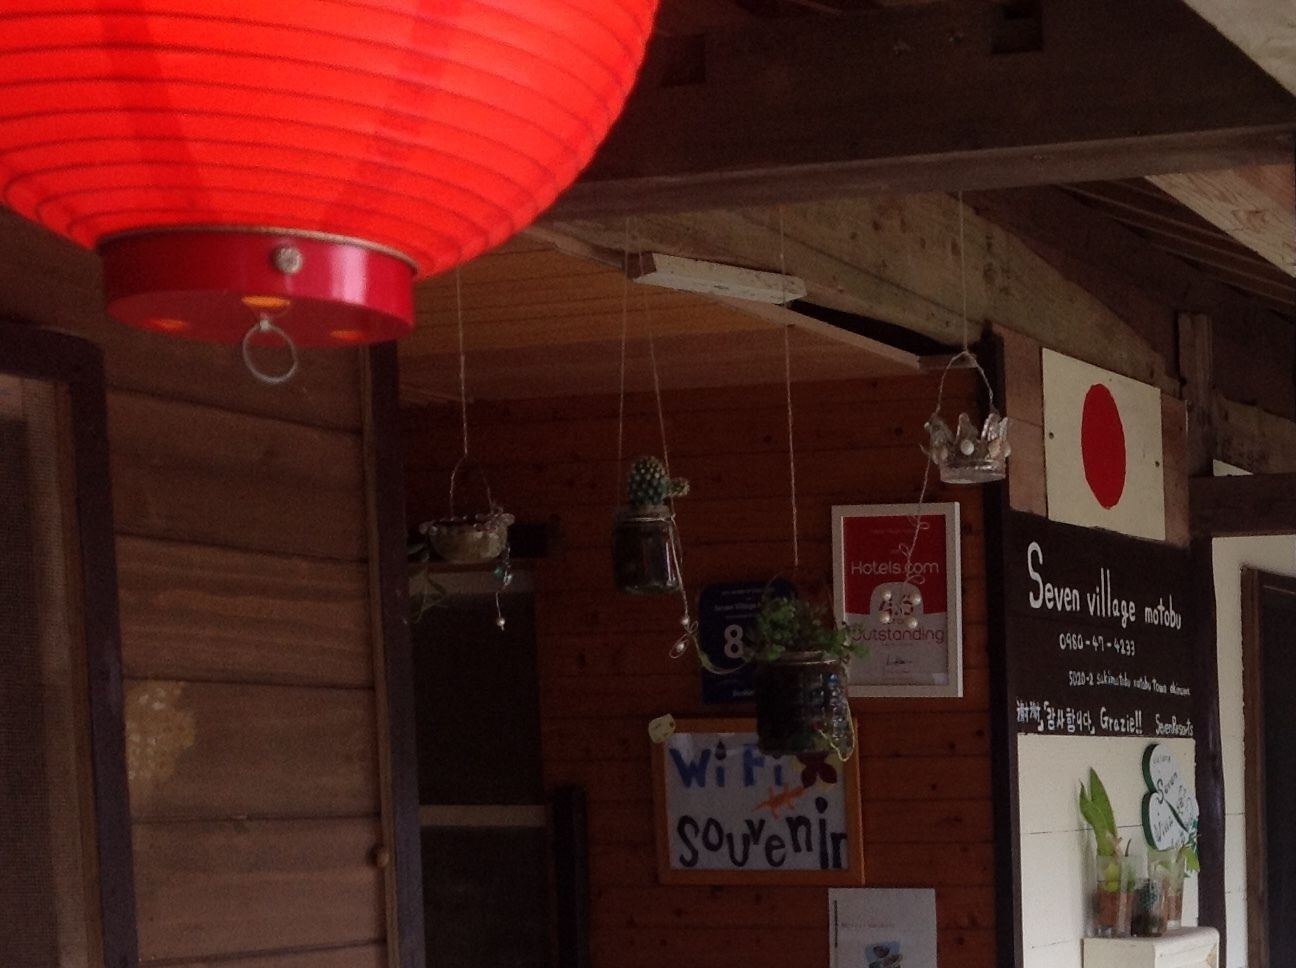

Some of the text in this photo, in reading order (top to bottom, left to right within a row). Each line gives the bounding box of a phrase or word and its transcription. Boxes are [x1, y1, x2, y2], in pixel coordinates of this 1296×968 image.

[851, 560, 939, 575] Hotels.com
[1027, 541, 1182, 630] Seven village motobu
[1099, 706, 1143, 734] Grazie!!
